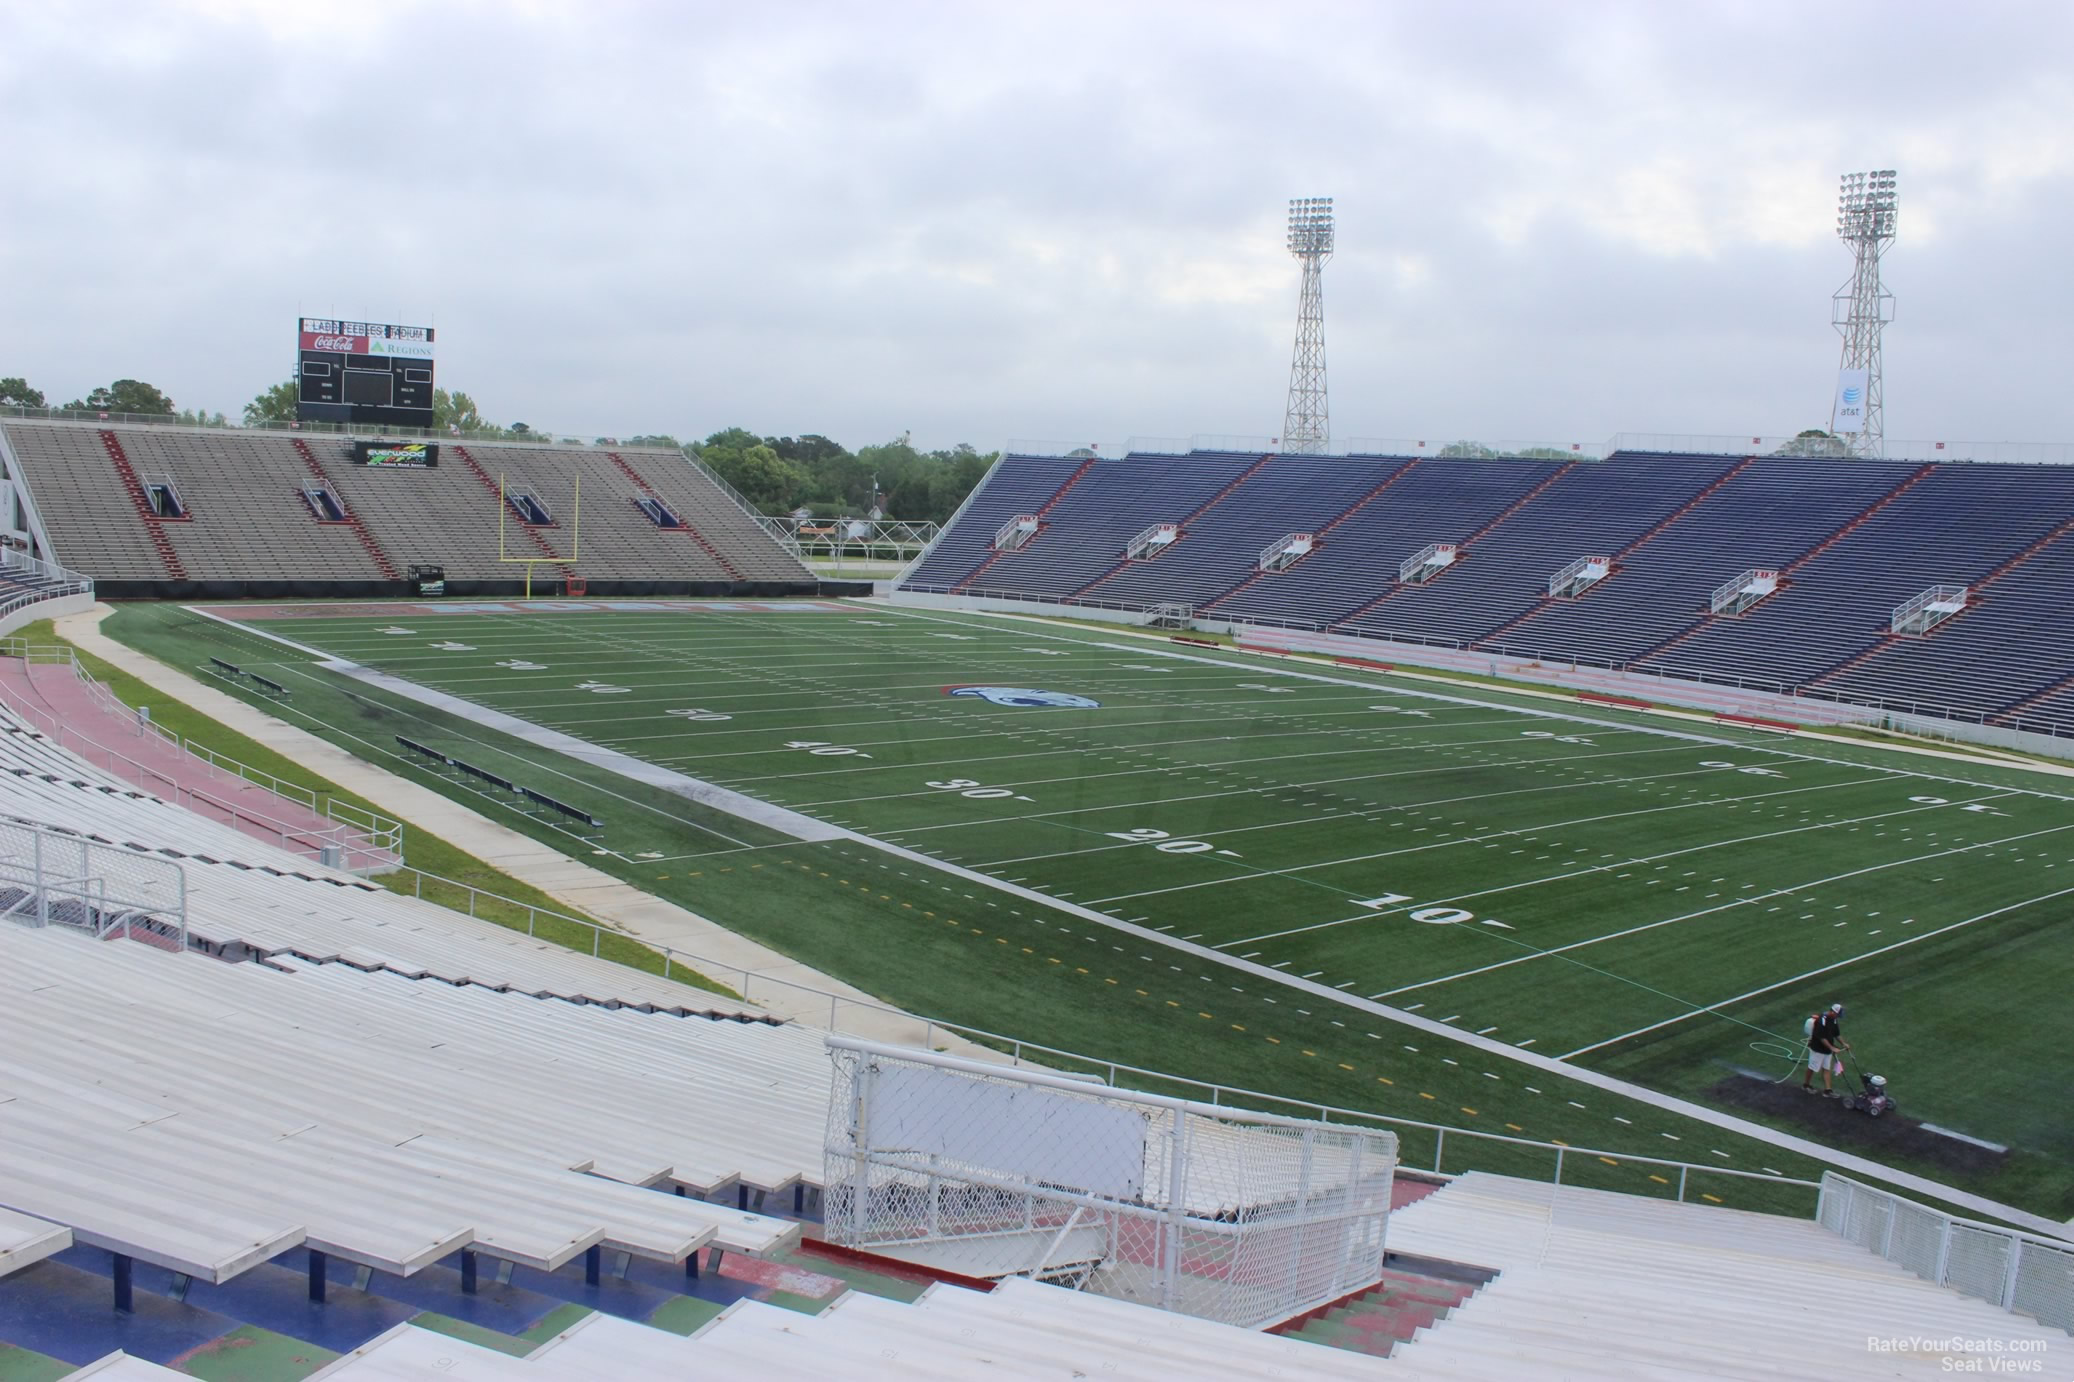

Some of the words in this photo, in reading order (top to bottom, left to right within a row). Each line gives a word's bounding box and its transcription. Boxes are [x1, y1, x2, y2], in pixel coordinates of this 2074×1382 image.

[1840, 407, 1860, 416] at&t
[1103, 828, 1215, 854] 20
[1348, 892, 1475, 925] 10
